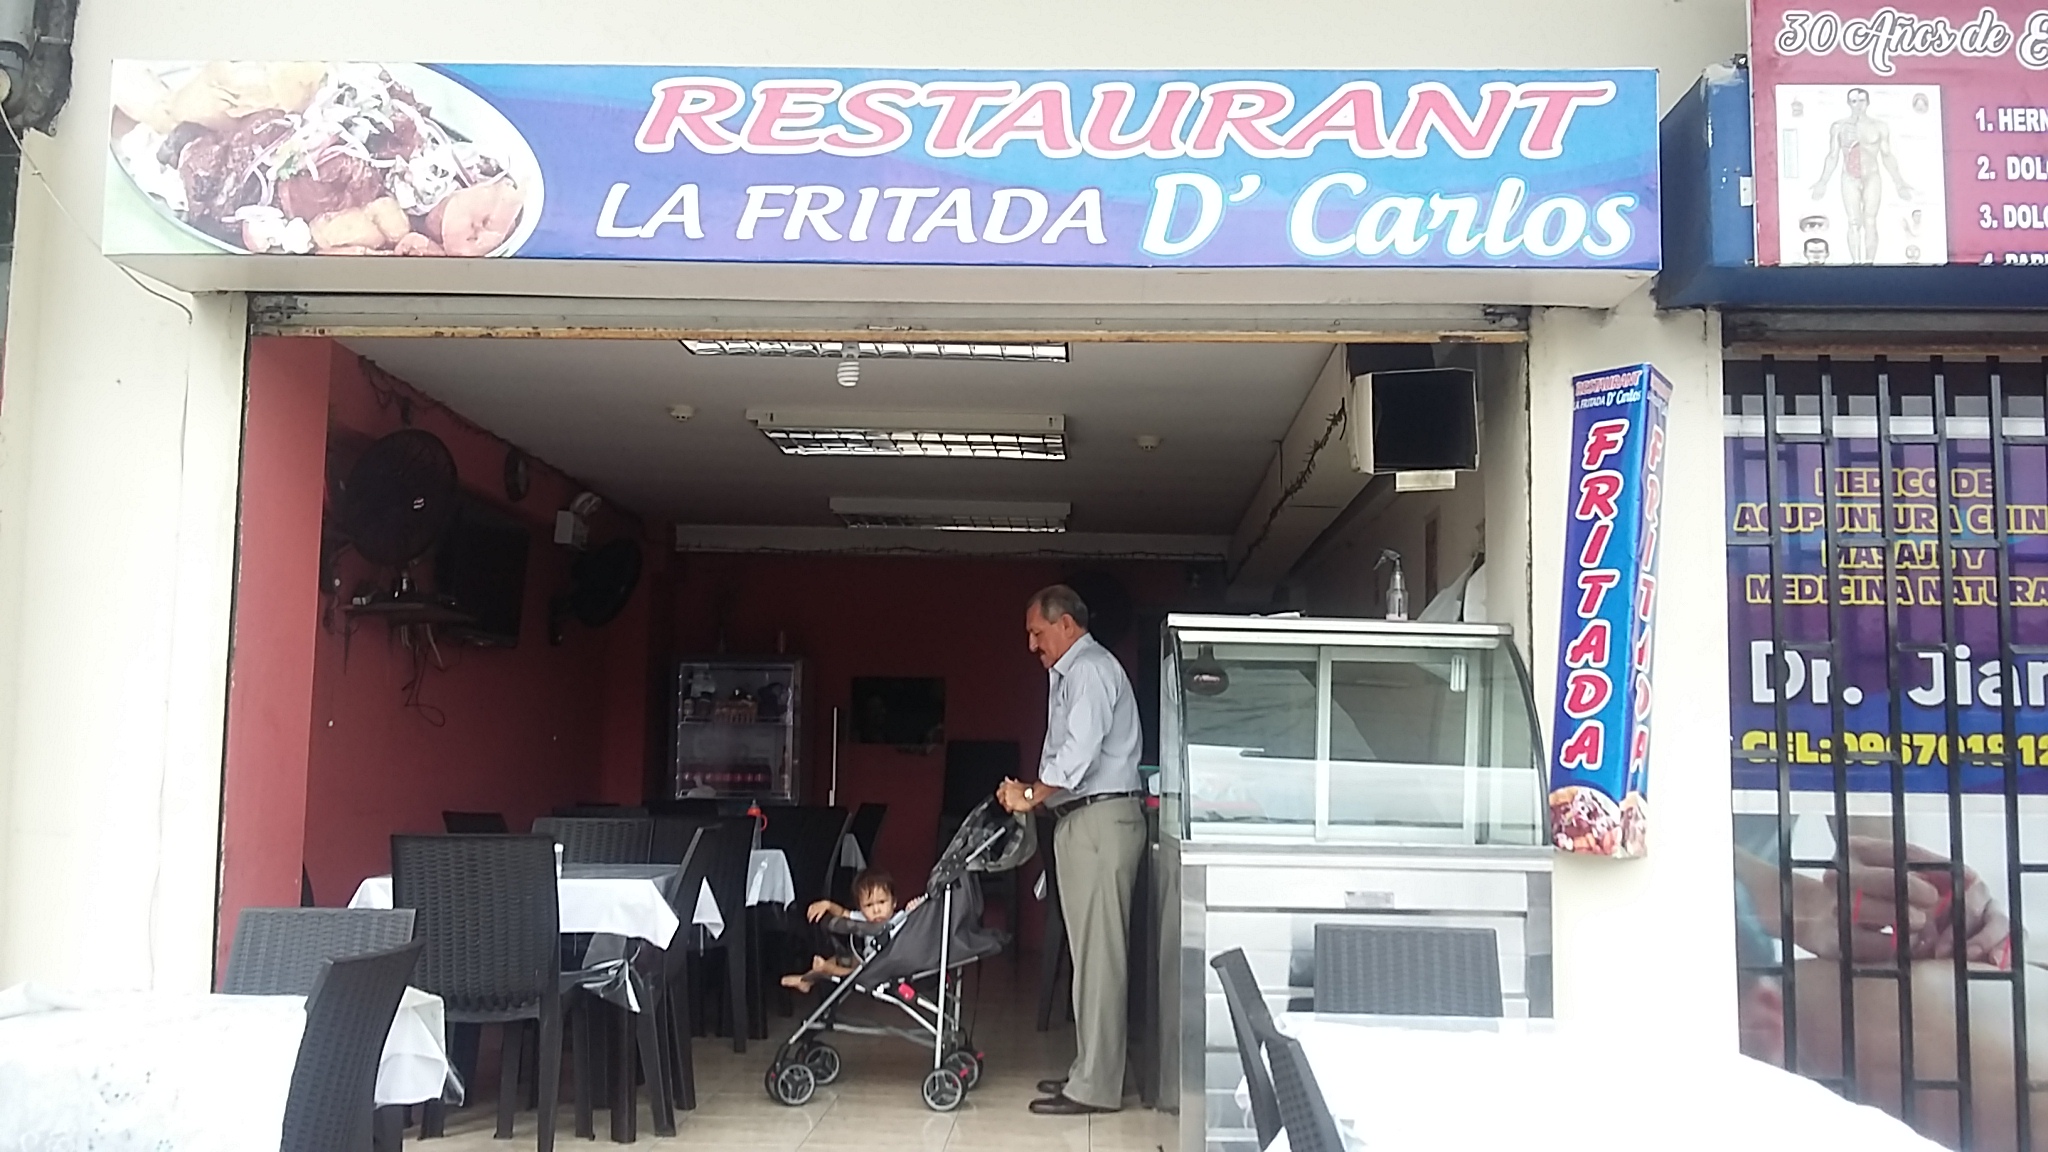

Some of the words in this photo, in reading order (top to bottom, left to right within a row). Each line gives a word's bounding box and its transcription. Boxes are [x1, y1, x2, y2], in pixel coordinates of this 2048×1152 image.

[1776, 10, 1841, 54] 30
[1842, 8, 1957, 76] Años
[1957, 8, 2014, 57] de
[634, 76, 1617, 161] RESTAURANT
[1975, 106, 1995, 132] 1.
[1976, 155, 1996, 180] 2.
[595, 182, 705, 239] LA
[735, 185, 1108, 245] FRITADA
[1140, 170, 1266, 262] D'
[1286, 170, 1640, 261] Carlos
[1979, 203, 1998, 229] 3.
[1952, 469, 1994, 498] DE
[1963, 549, 1986, 569] Y
[1559, 418, 1630, 771] FRITADA
[1746, 574, 1915, 605] MEDICINA
[1751, 641, 1863, 705] Dr.
